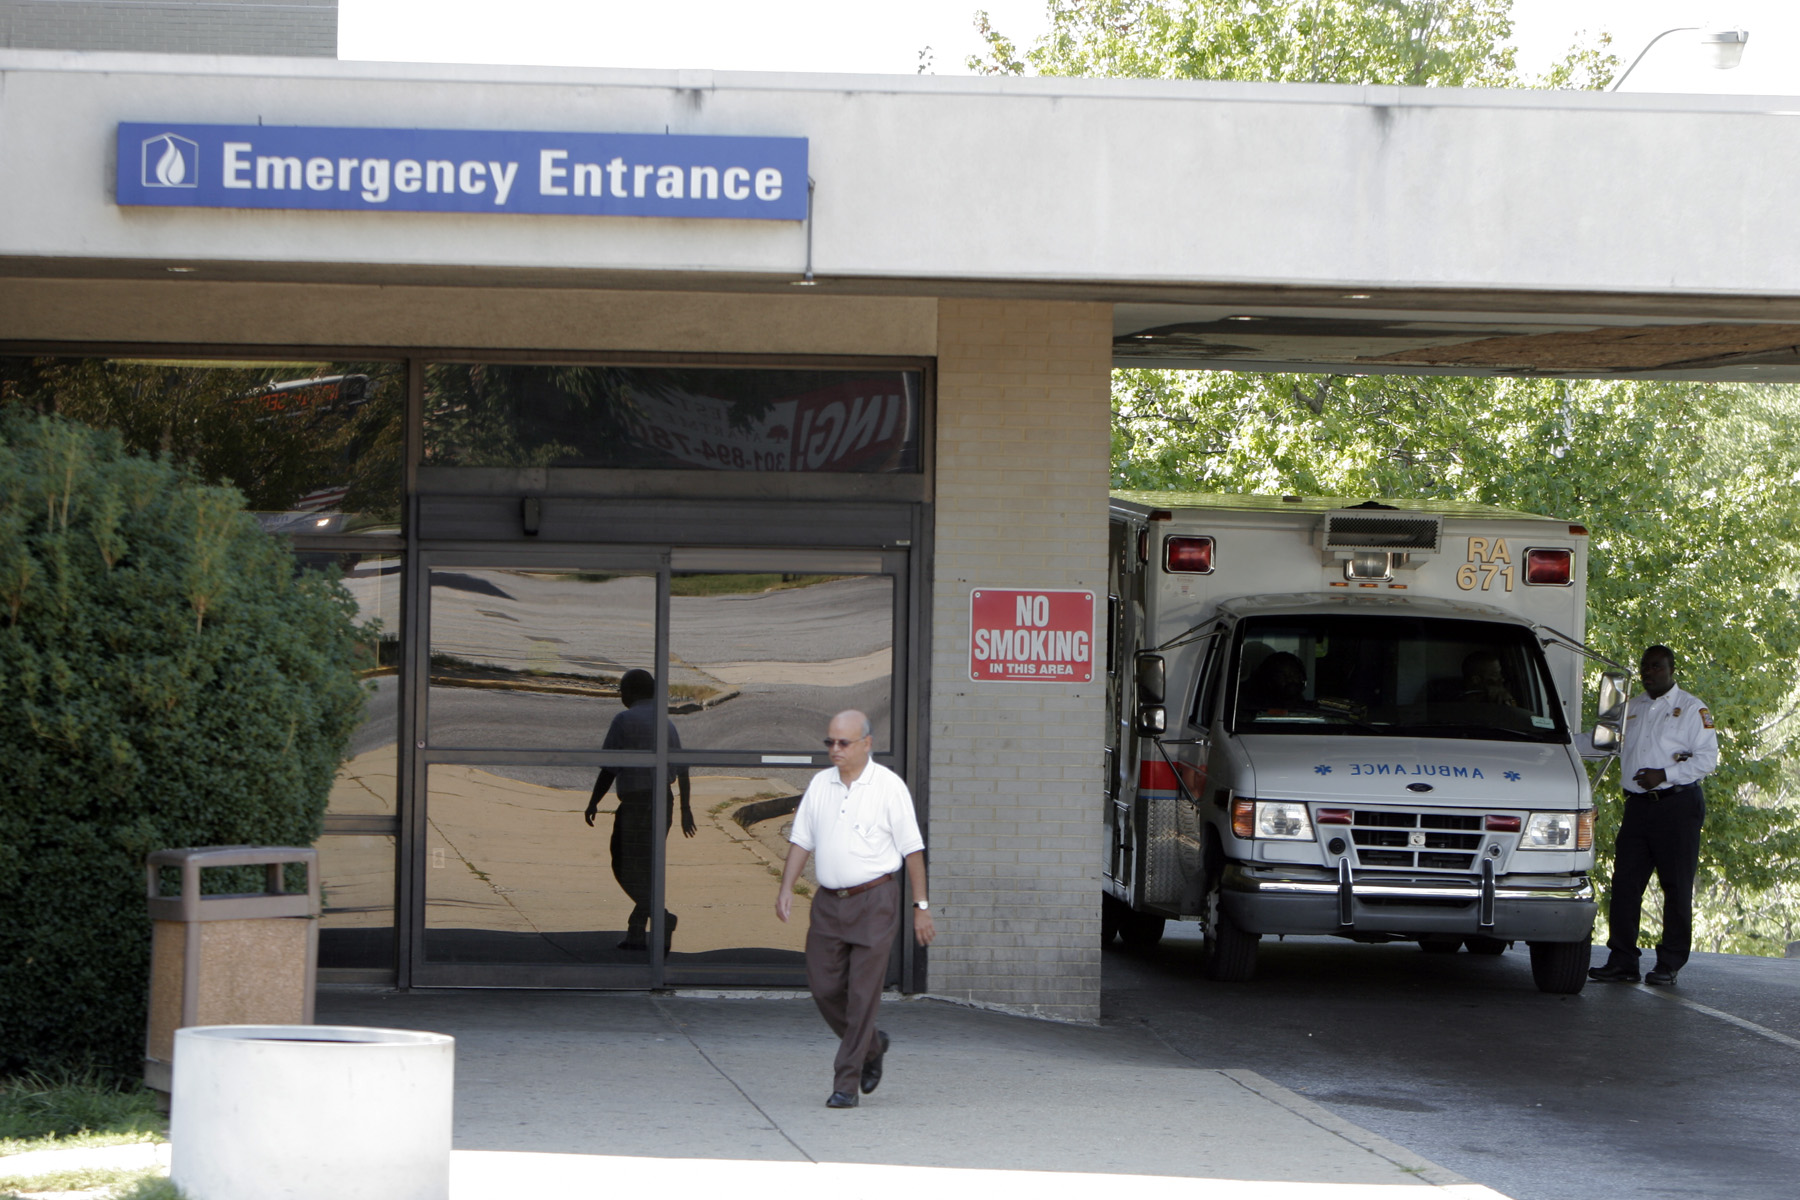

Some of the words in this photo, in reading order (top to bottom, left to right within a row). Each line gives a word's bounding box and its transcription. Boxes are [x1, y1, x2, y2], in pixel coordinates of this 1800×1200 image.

[222, 141, 518, 206] Emergency
[539, 148, 784, 203] Entrance
[1467, 536, 1511, 564] RA
[1456, 563, 1514, 592] 671
[1016, 595, 1050, 627] NO
[974, 628, 1089, 662] SMOKING
[989, 663, 1003, 673] IN
[1006, 663, 1036, 674] THIS
[1039, 664, 1074, 675] AREA
